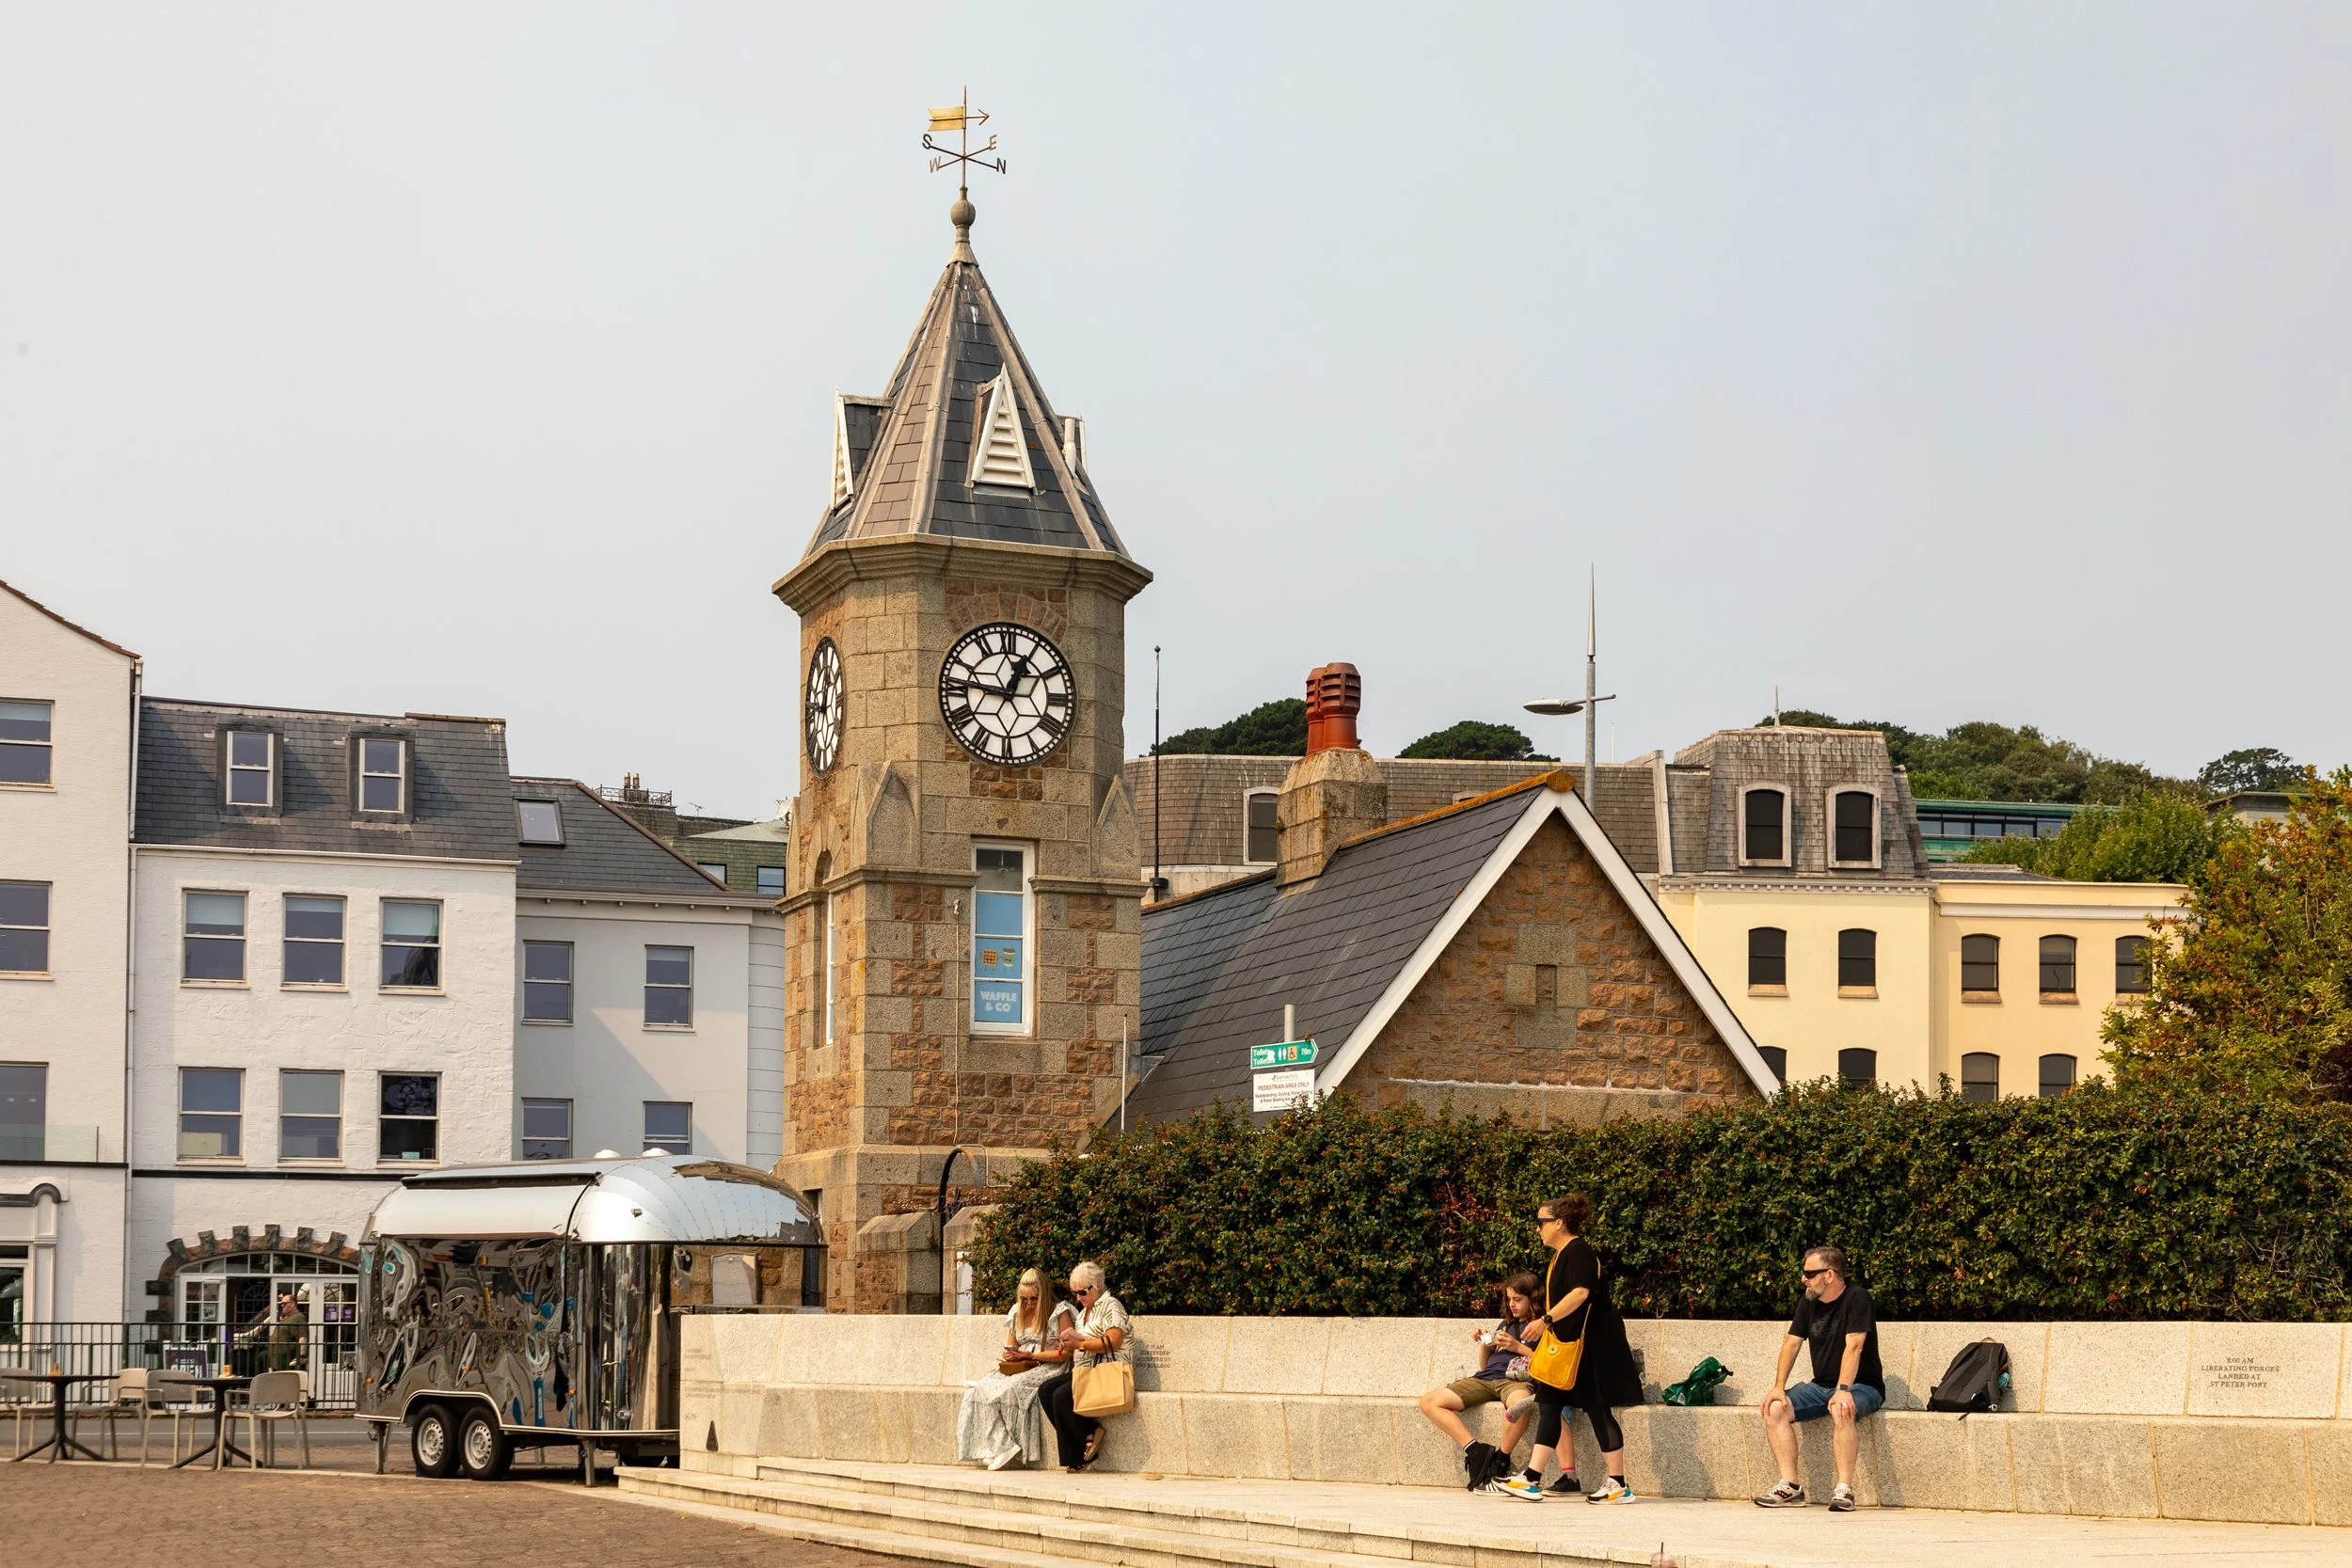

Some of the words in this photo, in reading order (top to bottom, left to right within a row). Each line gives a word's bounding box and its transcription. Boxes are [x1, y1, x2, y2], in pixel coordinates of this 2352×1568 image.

[922, 134, 932, 150] S
[989, 134, 997, 150] E
[930, 156, 942, 173] W
[996, 157, 1007, 174] N
[999, 632, 1016, 654] XII
[1048, 692, 1068, 706] III
[979, 990, 1017, 1002] WAFFLE
[985, 1001, 993, 1011] &
[995, 1002, 1011, 1012] CO
